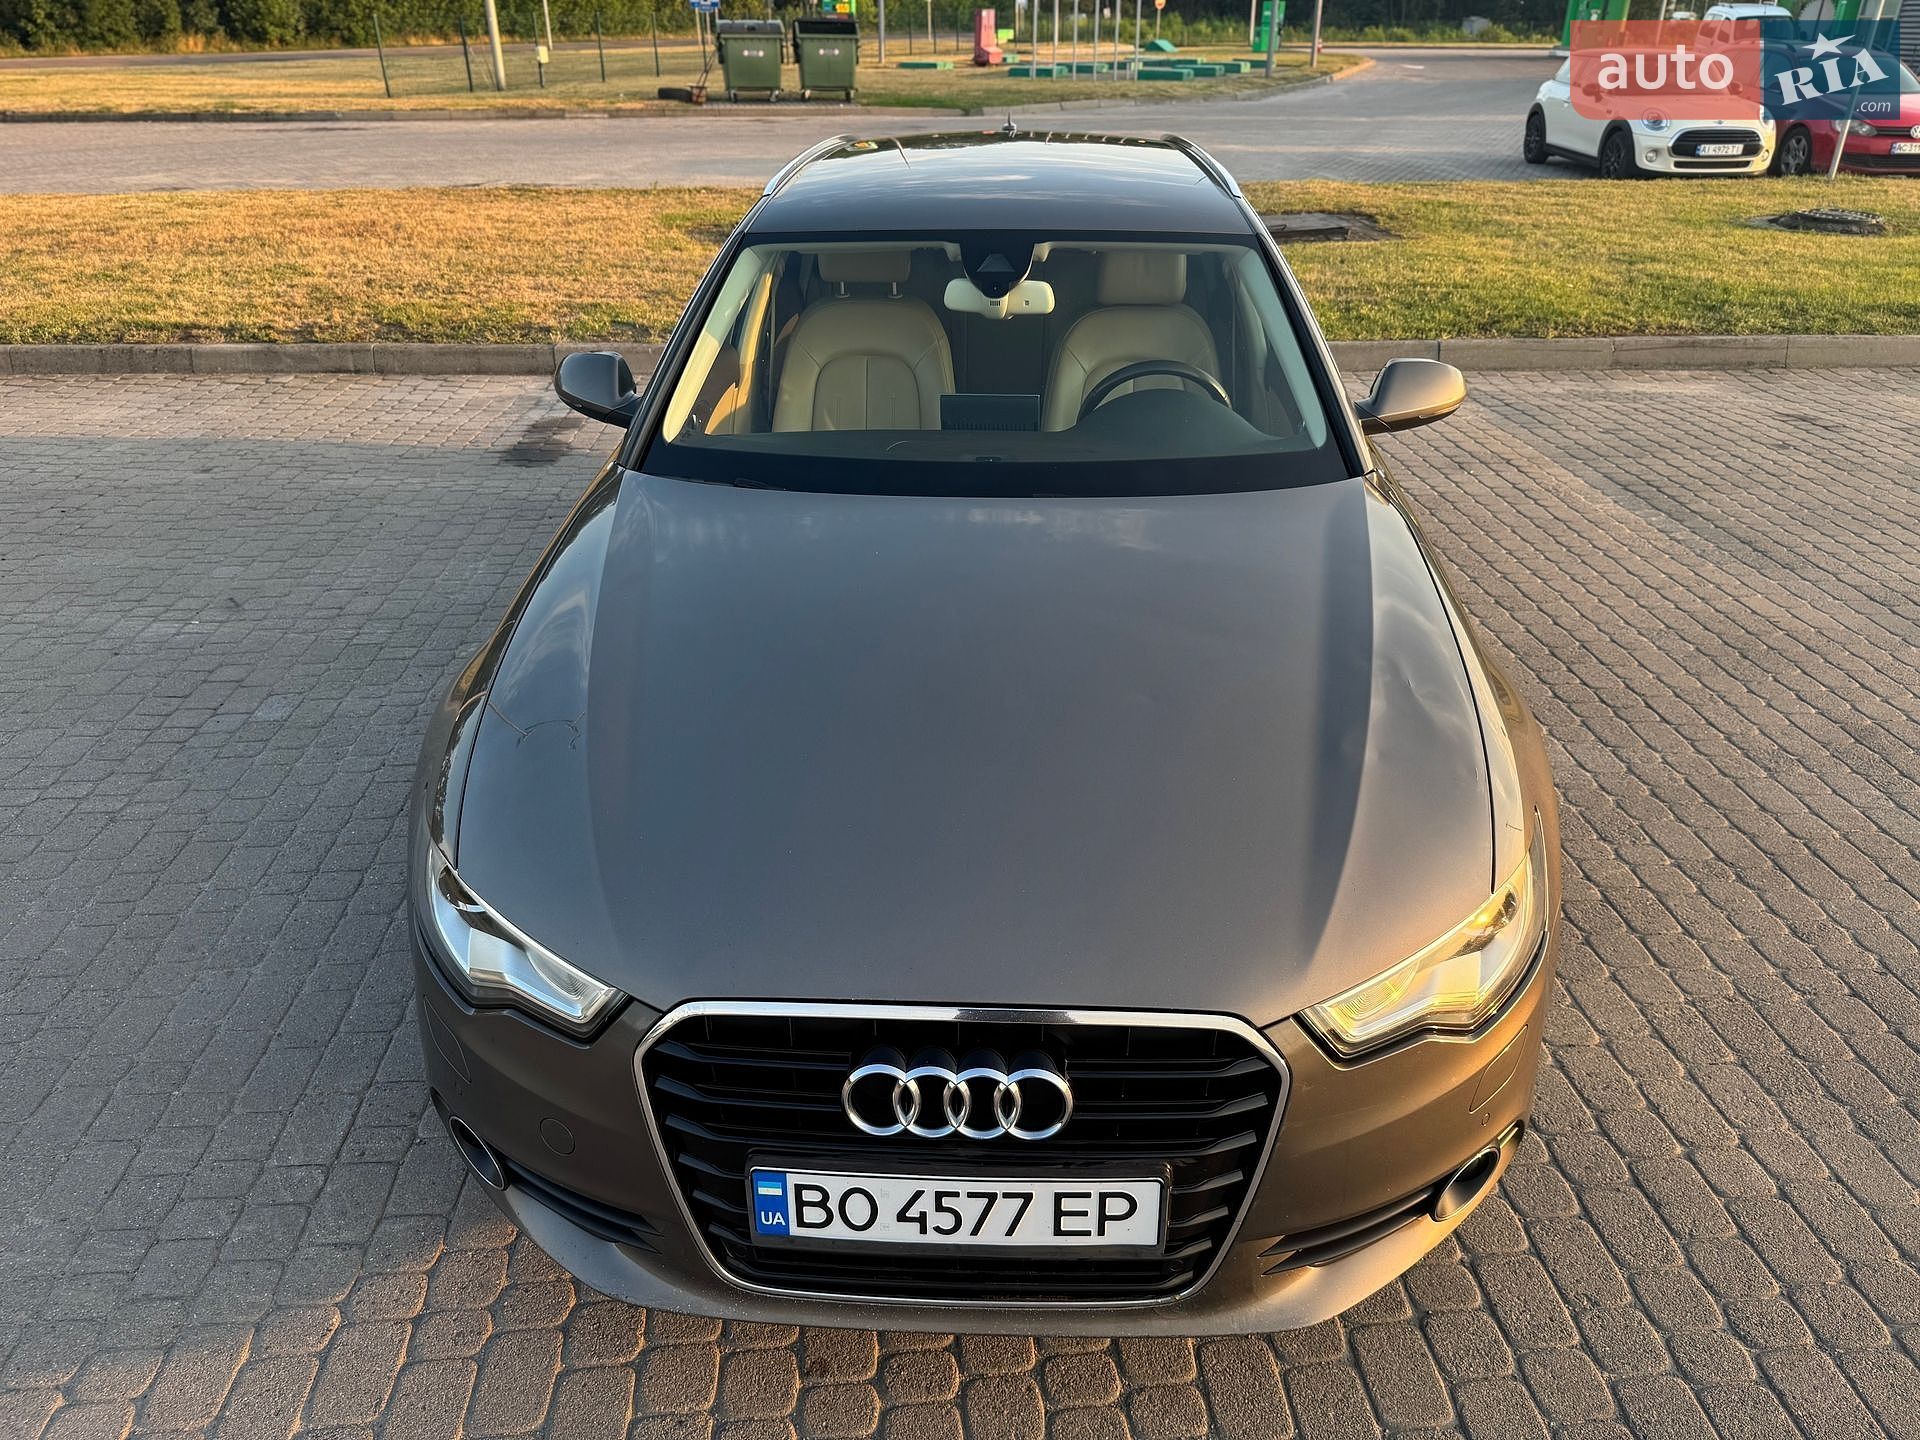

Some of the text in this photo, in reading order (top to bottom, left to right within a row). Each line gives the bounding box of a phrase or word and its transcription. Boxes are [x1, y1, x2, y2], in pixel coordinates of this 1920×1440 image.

[760, 1211, 786, 1226] UA
[793, 1183, 1139, 1237] BO 4577 EP
